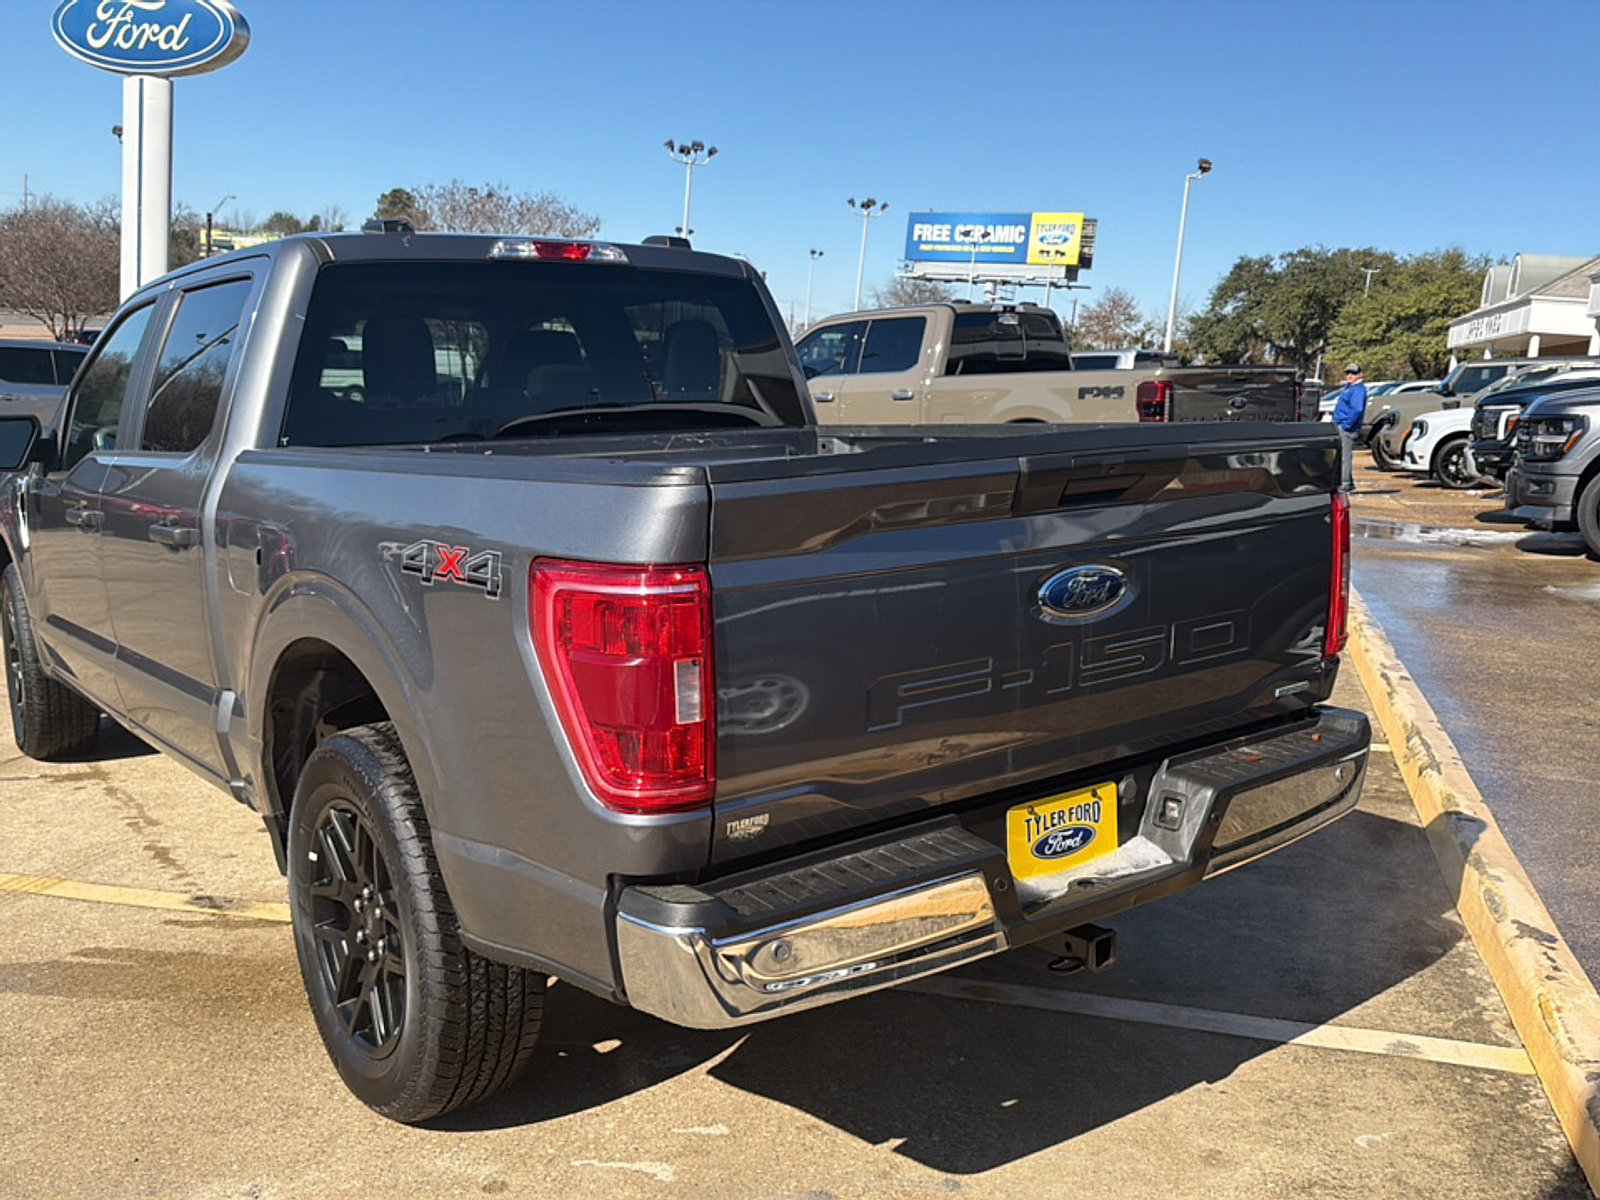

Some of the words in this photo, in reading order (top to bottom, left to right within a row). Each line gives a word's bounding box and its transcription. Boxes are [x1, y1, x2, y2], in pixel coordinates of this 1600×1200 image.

[86, 0, 193, 50] Ford
[913, 223, 951, 241] FREE
[954, 224, 1026, 244] CERAMIC
[1078, 386, 1125, 400] FX4
[1063, 574, 1112, 608] Ford
[867, 609, 1252, 732] F-150
[1024, 810, 1066, 844] TYLER
[1068, 800, 1101, 824] FORD
[1044, 829, 1084, 855] Ford
